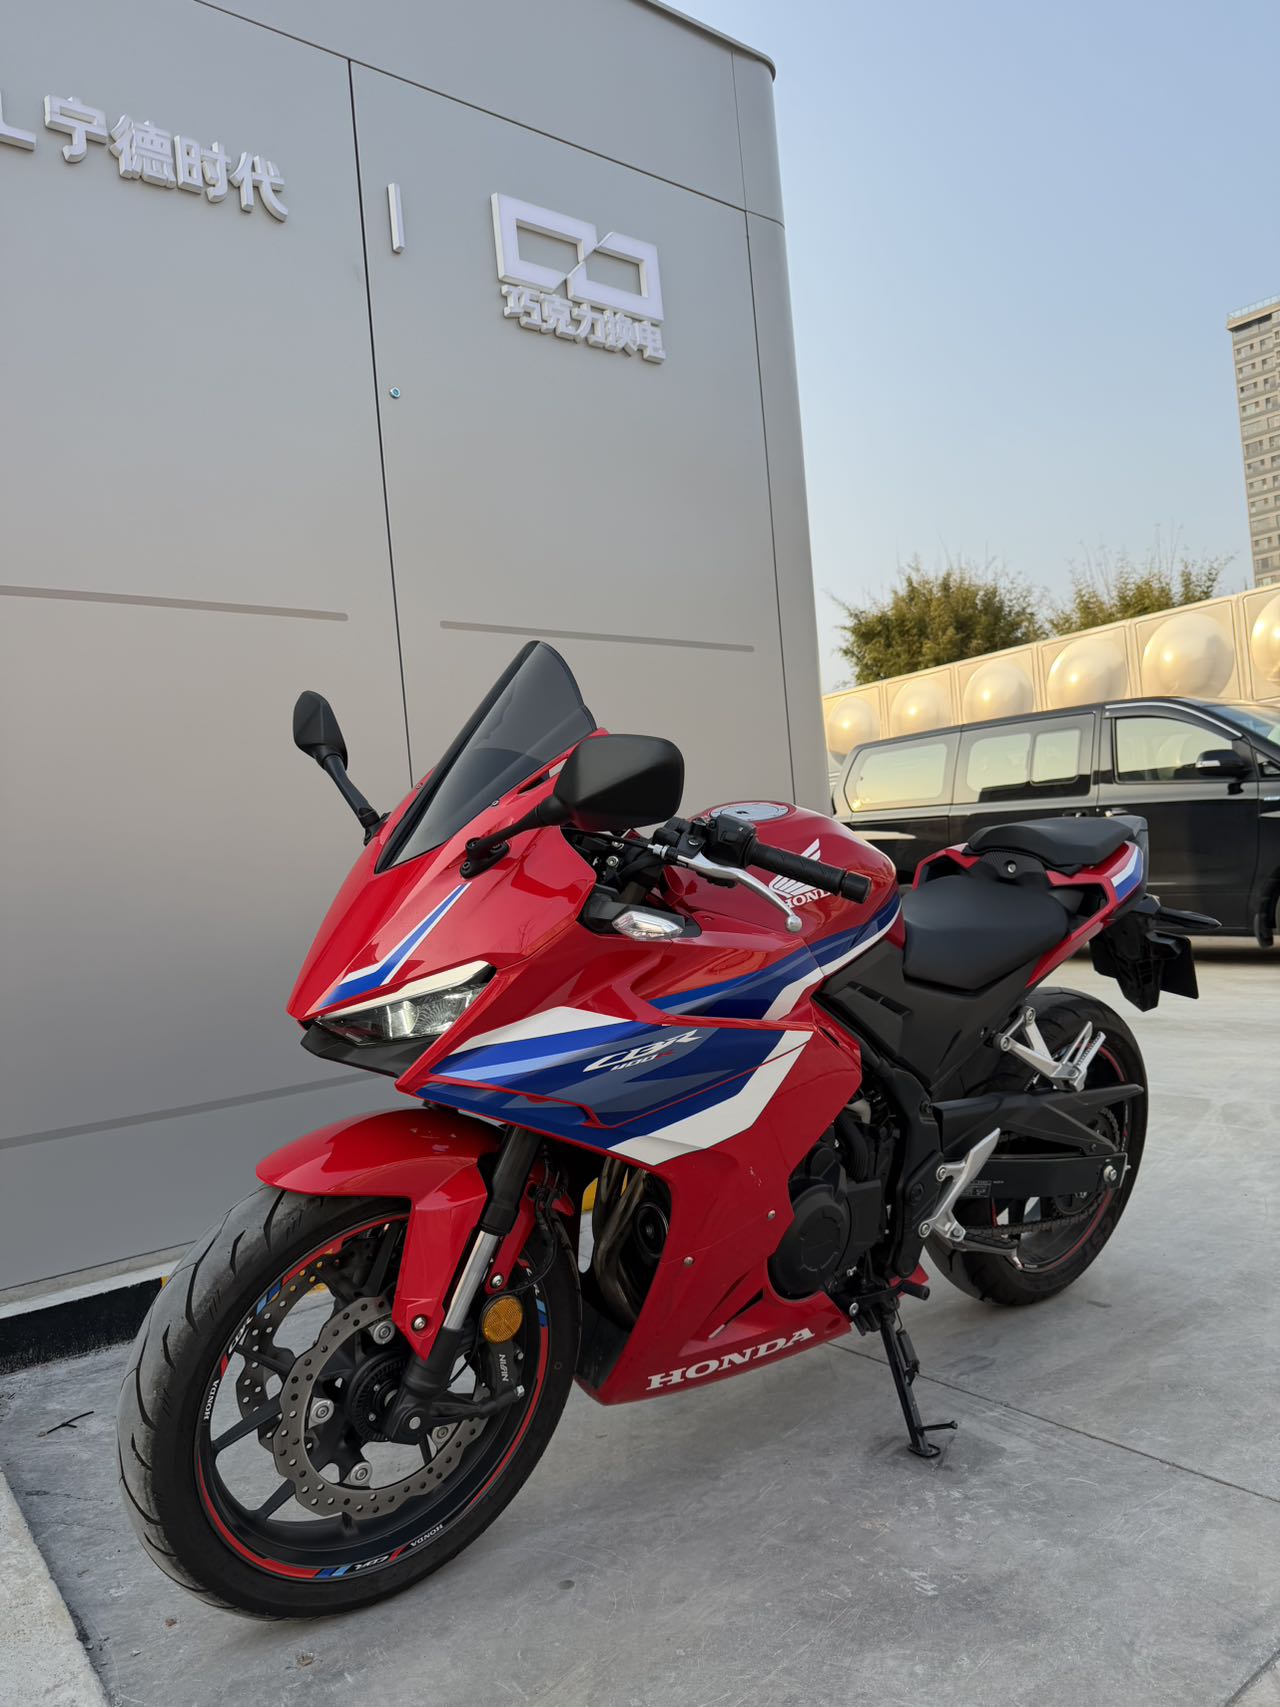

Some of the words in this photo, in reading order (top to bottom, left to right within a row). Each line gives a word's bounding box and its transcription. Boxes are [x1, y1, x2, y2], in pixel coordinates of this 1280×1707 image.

[44, 95, 289, 223] 宁德时代
[501, 284, 667, 364] 巧克力换电
[582, 1028, 703, 1073] CBR
[646, 1327, 816, 1391] HONDA
[203, 1379, 221, 1420] HONDA
[410, 1523, 444, 1547] HONDA
